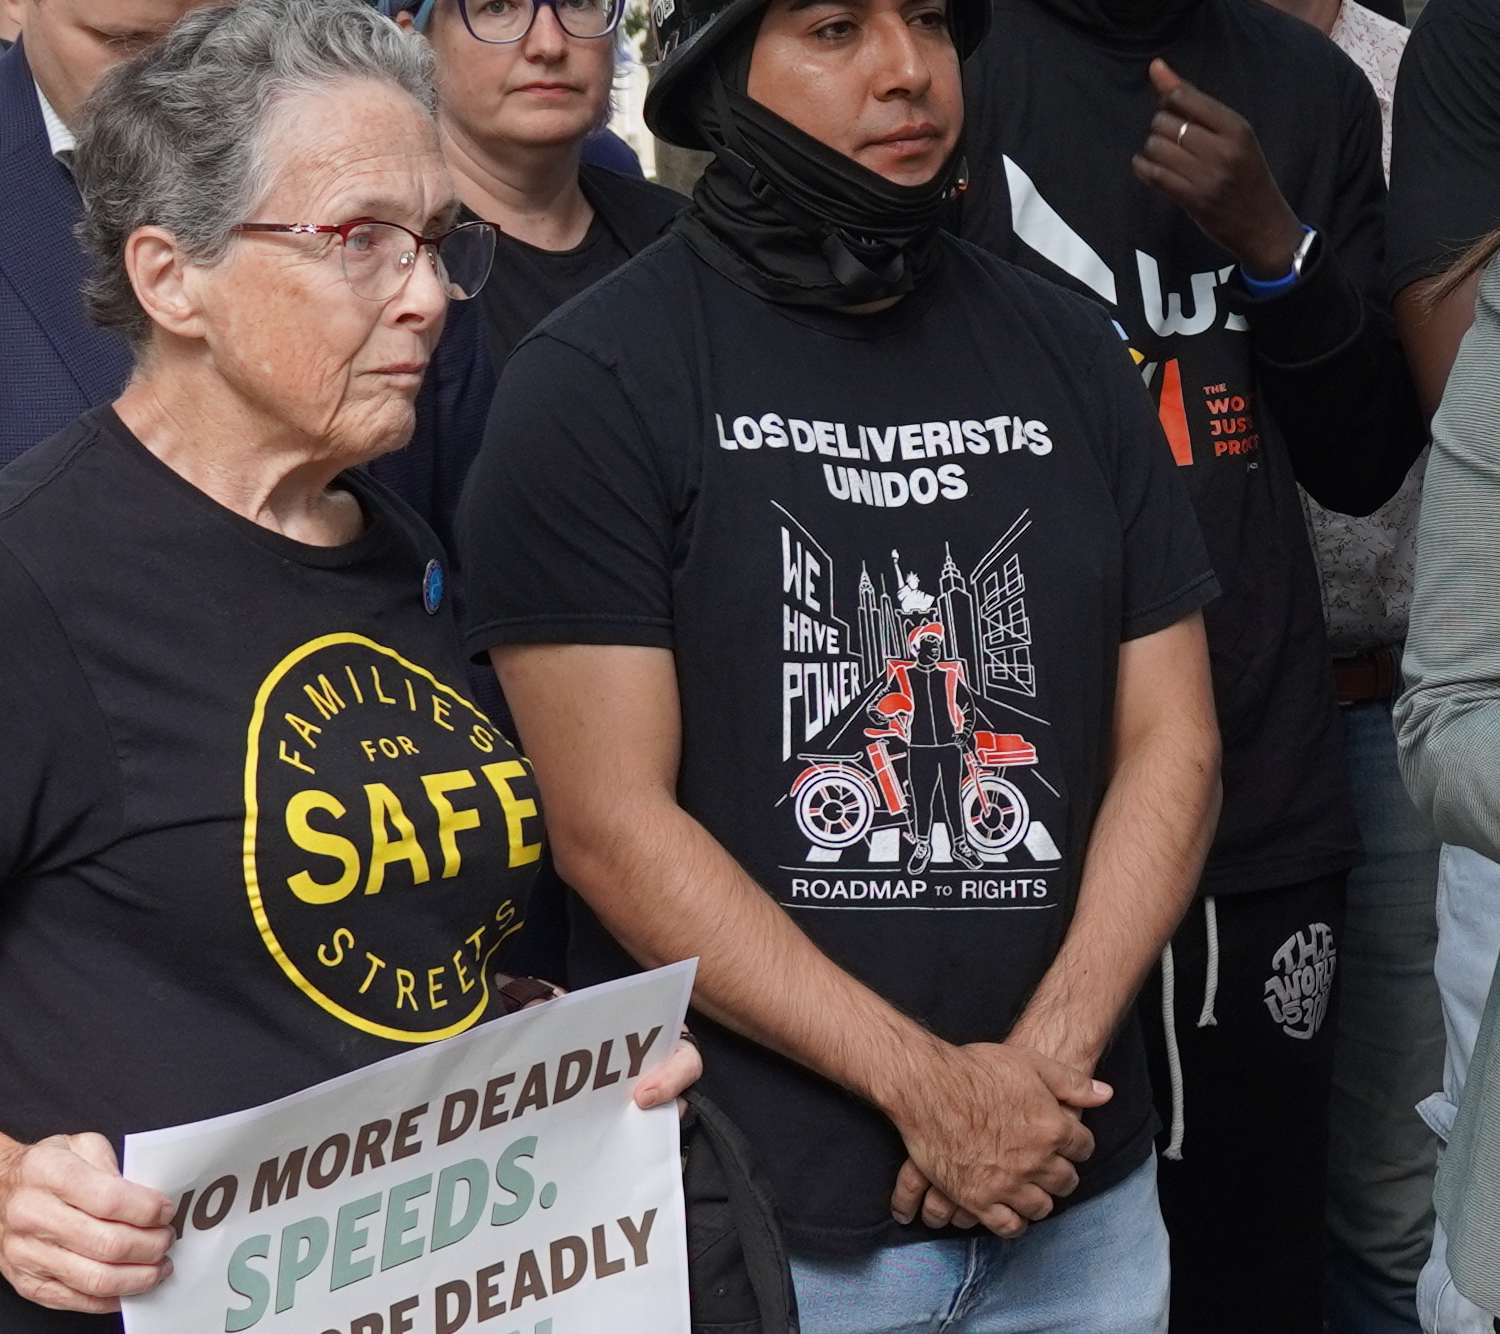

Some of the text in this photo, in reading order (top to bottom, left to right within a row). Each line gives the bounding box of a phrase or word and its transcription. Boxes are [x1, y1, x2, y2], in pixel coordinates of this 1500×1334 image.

[1203, 383, 1227, 394] THE
[715, 412, 1053, 463] LOS DELIVERISTAS
[823, 463, 969, 508] UNIDOS
[781, 526, 822, 609] WE
[782, 605, 839, 653] HAVE
[278, 662, 494, 775] FAMILIES
[362, 734, 420, 761] FOR
[782, 655, 862, 762] POWER
[284, 761, 544, 905] SAFE
[791, 879, 1048, 900] ROADMAP TO RIGHTS
[317, 897, 521, 1012] STREETS
[1273, 923, 1336, 973] THE
[249, 1109, 424, 1206] MORE
[437, 1026, 666, 1147] DEADLY
[223, 1134, 559, 1334] SPEEDS.
[433, 1209, 658, 1334] DEADLY
